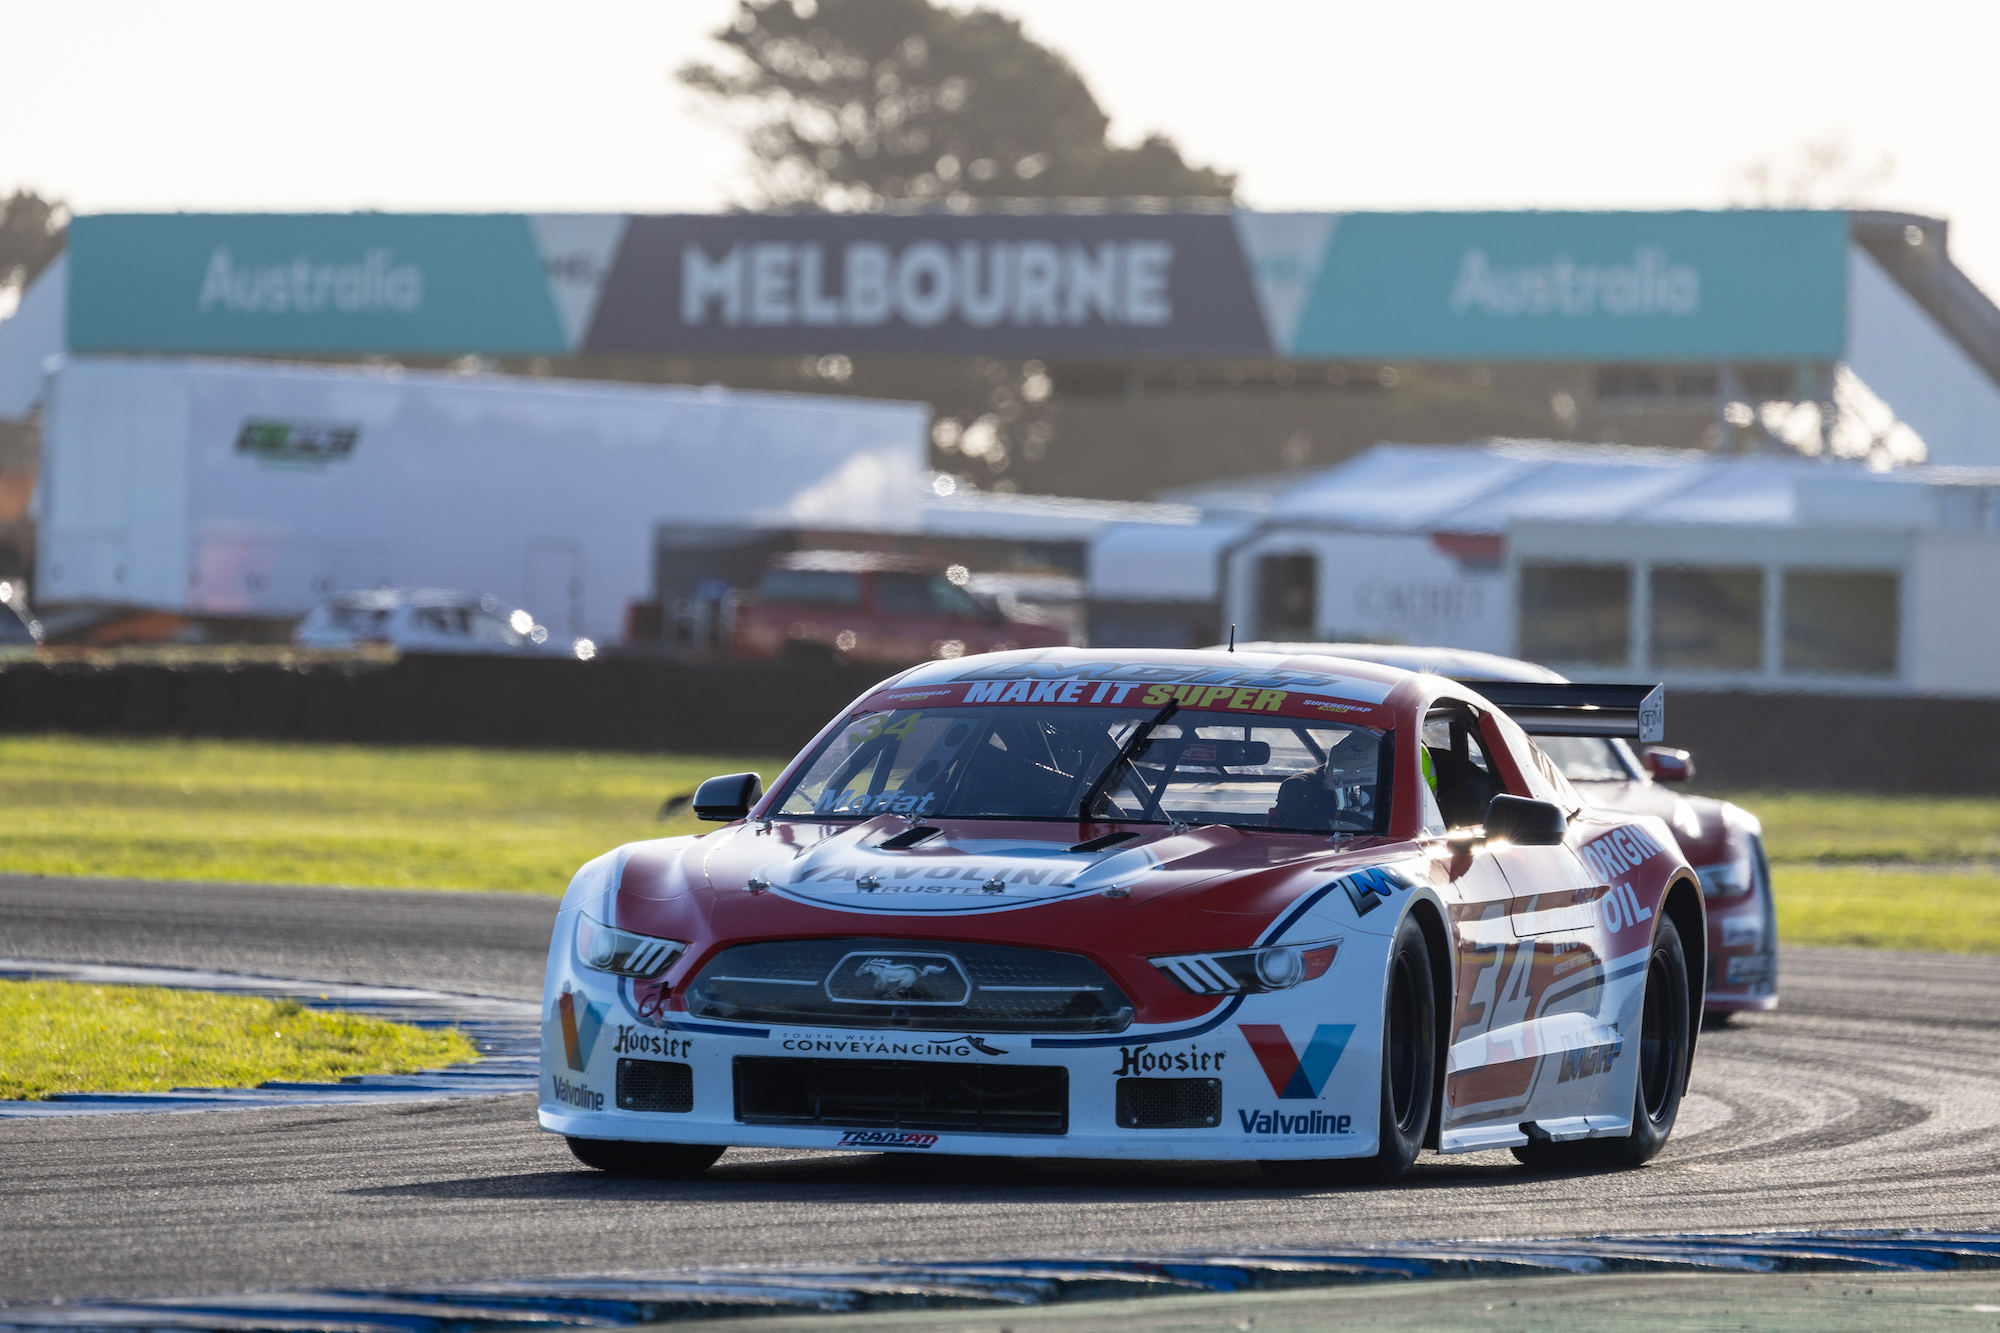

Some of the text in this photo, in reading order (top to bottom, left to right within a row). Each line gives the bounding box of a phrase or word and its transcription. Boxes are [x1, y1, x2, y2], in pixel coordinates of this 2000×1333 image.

[202, 248, 422, 312] Australia
[682, 241, 1172, 325] MELBOURNE
[1453, 246, 1698, 314] Australia
[886, 690, 951, 700] SUPERCHEAP
[962, 682, 1288, 711] MAKE IT SUPER
[1303, 699, 1372, 712] SUPERCHEAP
[849, 712, 923, 743] 34
[813, 789, 935, 813] Moffat
[1602, 882, 1652, 933] OIL
[1453, 893, 1539, 1072] 34
[613, 1024, 692, 1058] Hoosier
[783, 1040, 970, 1056] CONVEYANCING
[1112, 1044, 1226, 1076] Hoosier
[553, 1075, 604, 1111] Valvoline
[1238, 1110, 1354, 1134] Valvoline
